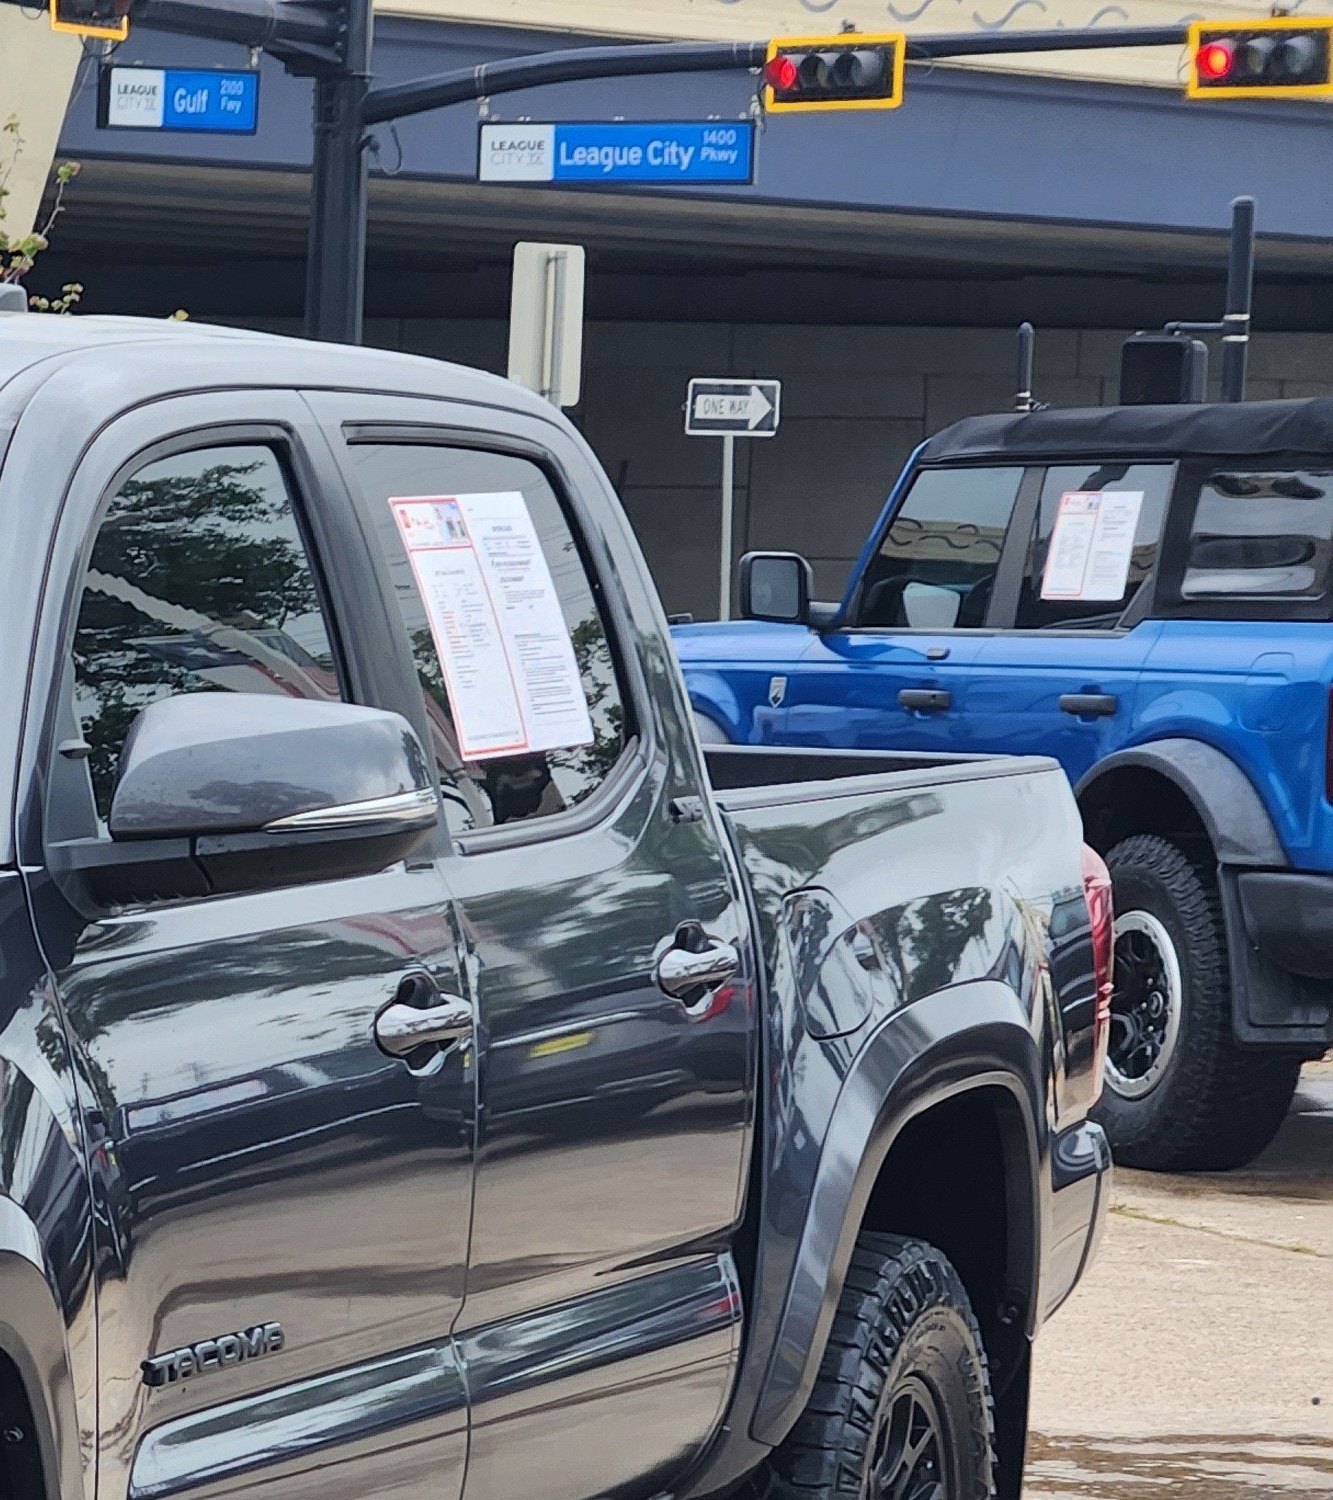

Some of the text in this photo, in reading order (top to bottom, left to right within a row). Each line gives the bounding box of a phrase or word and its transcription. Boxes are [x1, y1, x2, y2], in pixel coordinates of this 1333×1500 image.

[117, 83, 158, 96] LEAGUE
[116, 96, 144, 109] CITY
[174, 87, 209, 114] Gulf
[220, 96, 242, 115] Fwy
[491, 140, 545, 151] LEAGUE
[703, 129, 737, 145] 1400
[490, 152, 525, 166] CITY
[559, 140, 696, 173] League City
[700, 147, 738, 165] Pkwy
[703, 397, 749, 416] ONE WAY
[140, 1320, 286, 1387] TACOMA
